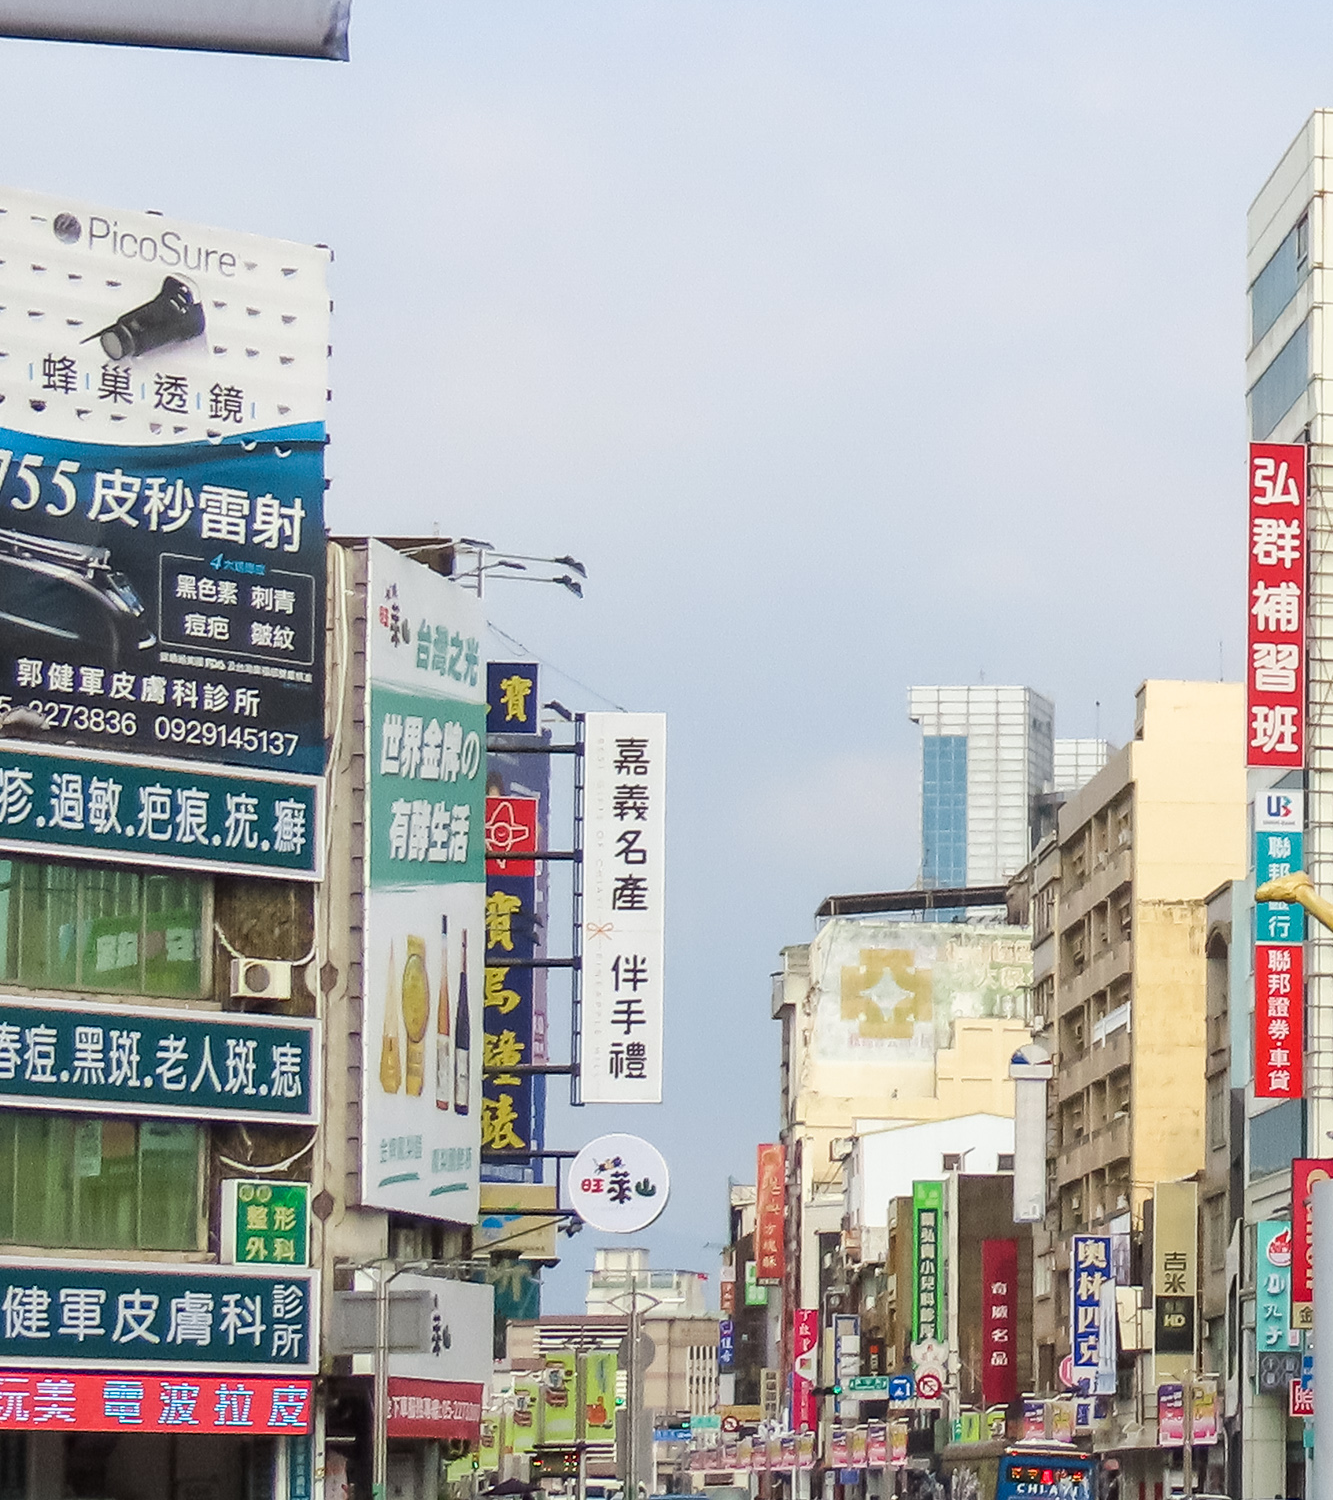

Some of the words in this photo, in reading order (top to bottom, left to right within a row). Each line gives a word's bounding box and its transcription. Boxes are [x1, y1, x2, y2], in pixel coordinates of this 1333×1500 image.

[88, 216, 237, 277] PicoSure
[41, 352, 244, 424] 蜂巢透鏡
[176, 574, 239, 606] 黑色素
[250, 585, 296, 615] 刺青
[184, 612, 230, 641] 痘疤
[1250, 456, 1301, 754] 弘群補習班
[416, 618, 479, 687] 台灣之光
[16, 657, 261, 718] 郭健軍皮膚科診所
[154, 715, 300, 758] 0929145137
[613, 737, 651, 911] 嘉義名產
[609, 954, 649, 1079] 伴手禮
